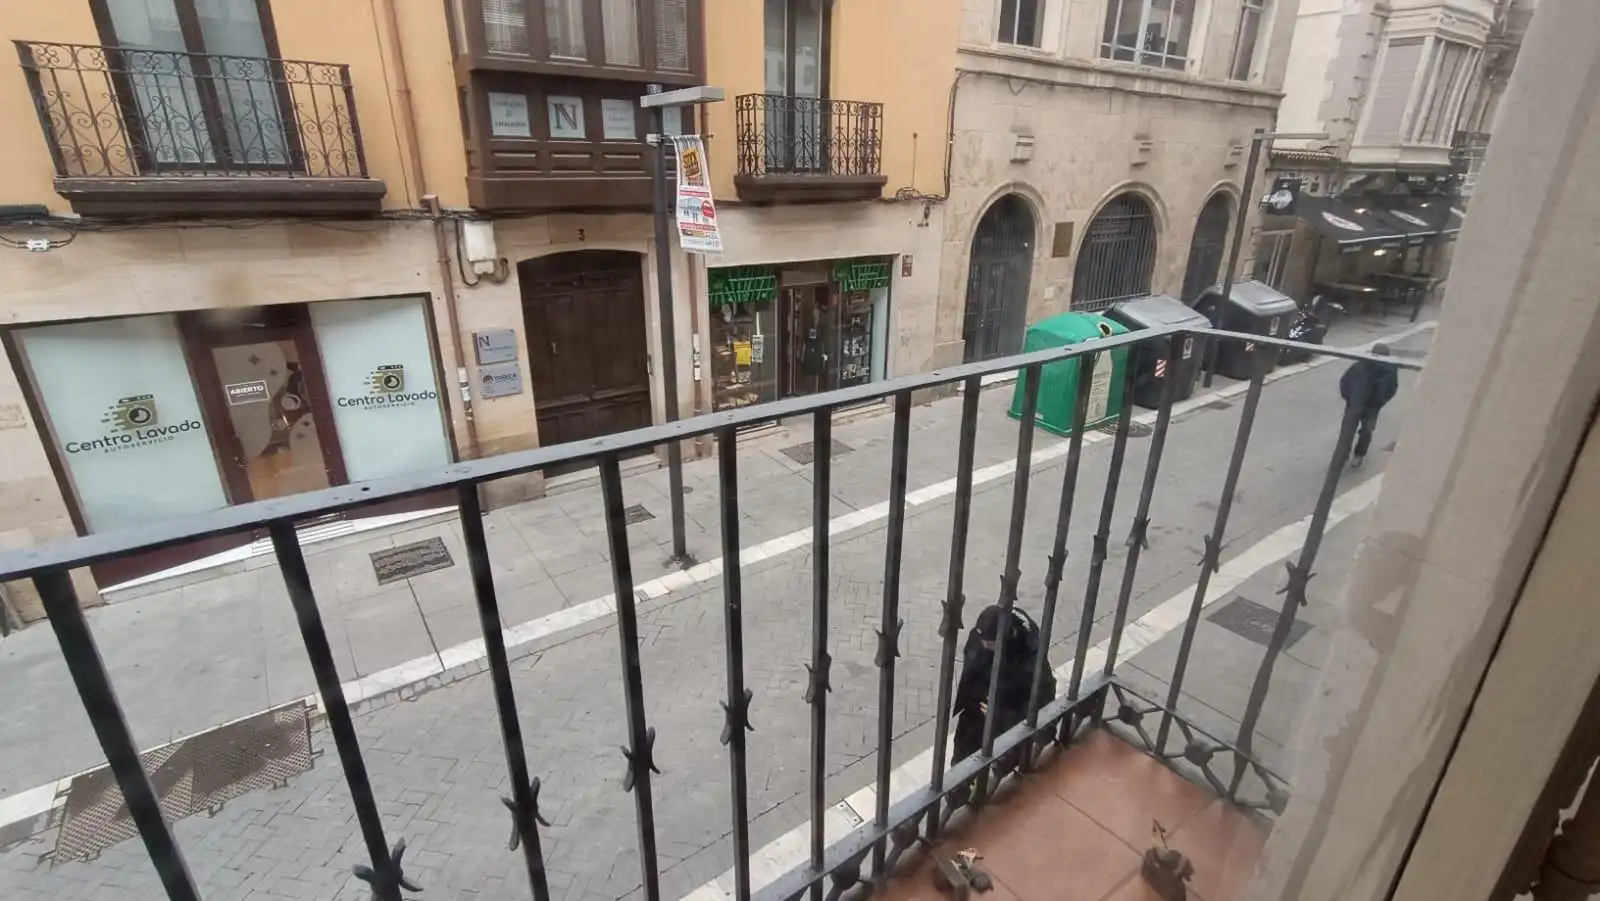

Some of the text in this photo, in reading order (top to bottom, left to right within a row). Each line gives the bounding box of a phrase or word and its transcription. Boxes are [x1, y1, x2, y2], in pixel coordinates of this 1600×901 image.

[552, 103, 578, 130] N
[578, 228, 586, 242] 3
[479, 335, 490, 347] N
[230, 385, 264, 395] ABIERTO
[338, 389, 437, 408] Centro Lavado
[65, 419, 201, 454] Centro Lavado
[104, 434, 175, 454] AUTOSERVICIO
